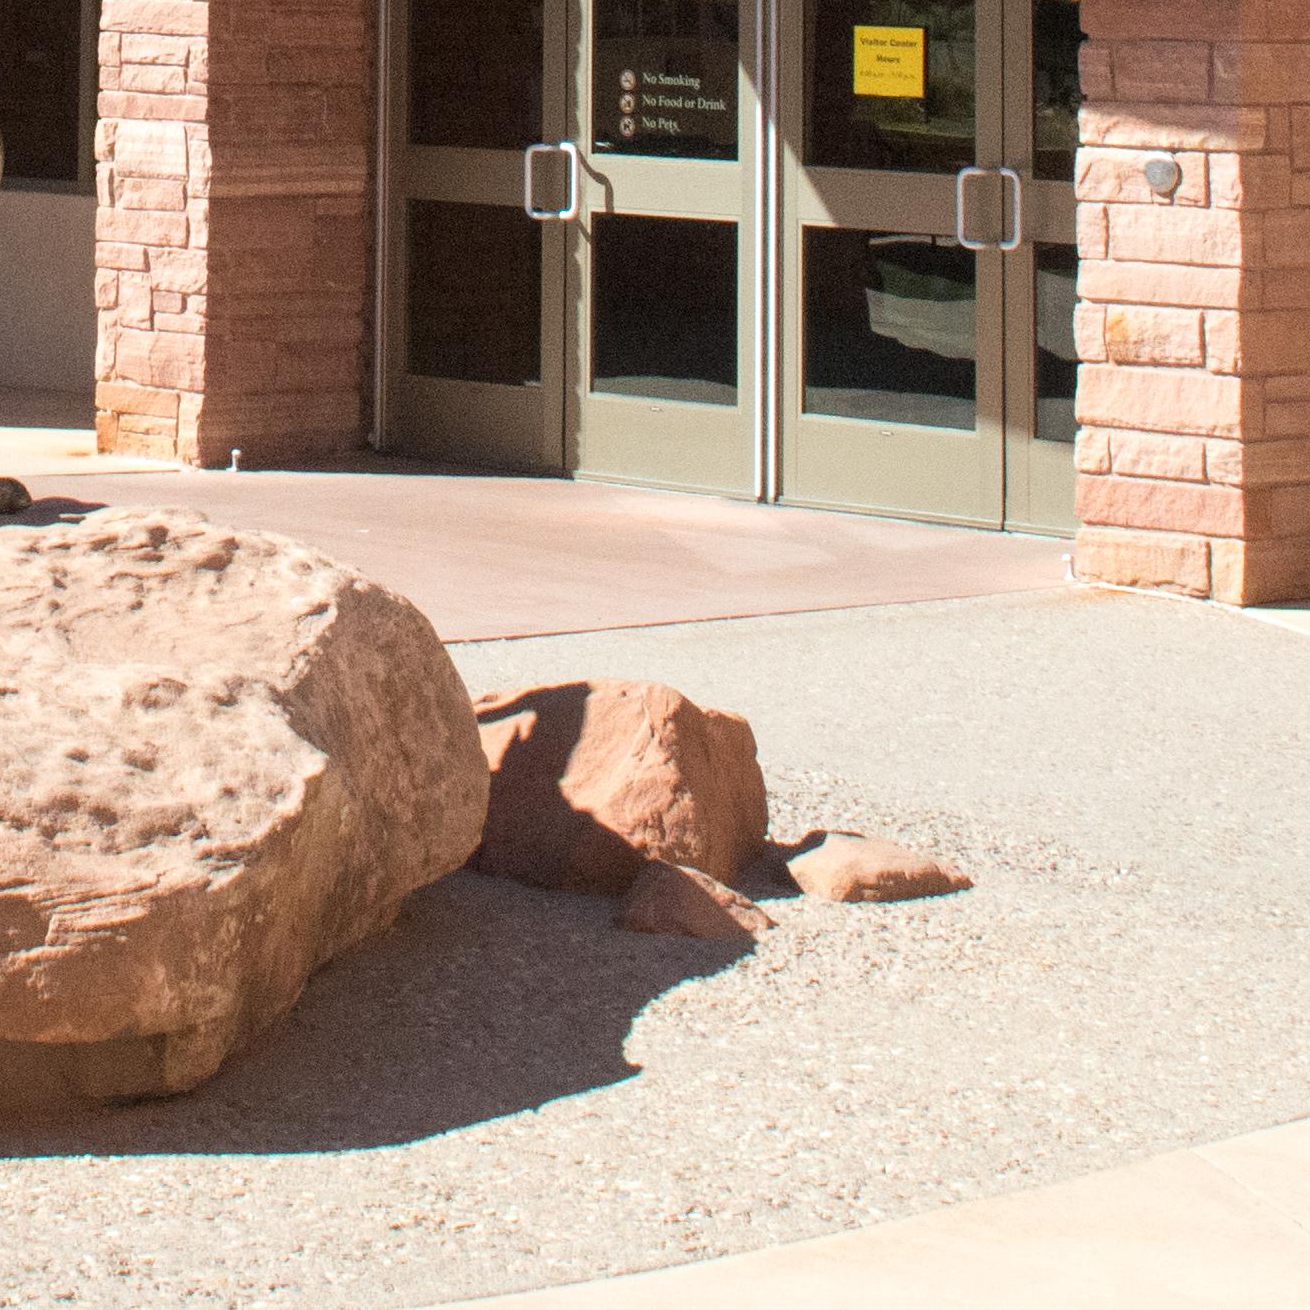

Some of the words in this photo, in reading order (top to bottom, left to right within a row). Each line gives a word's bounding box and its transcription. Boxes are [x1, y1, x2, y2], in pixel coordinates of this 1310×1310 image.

[642, 72, 657, 84] No
[658, 73, 700, 90] Smoking
[642, 94, 656, 107] No
[658, 95, 682, 108] Food
[684, 100, 696, 109] or
[697, 97, 726, 111] Drink
[642, 116, 656, 128] No
[658, 117, 678, 131] Pets
